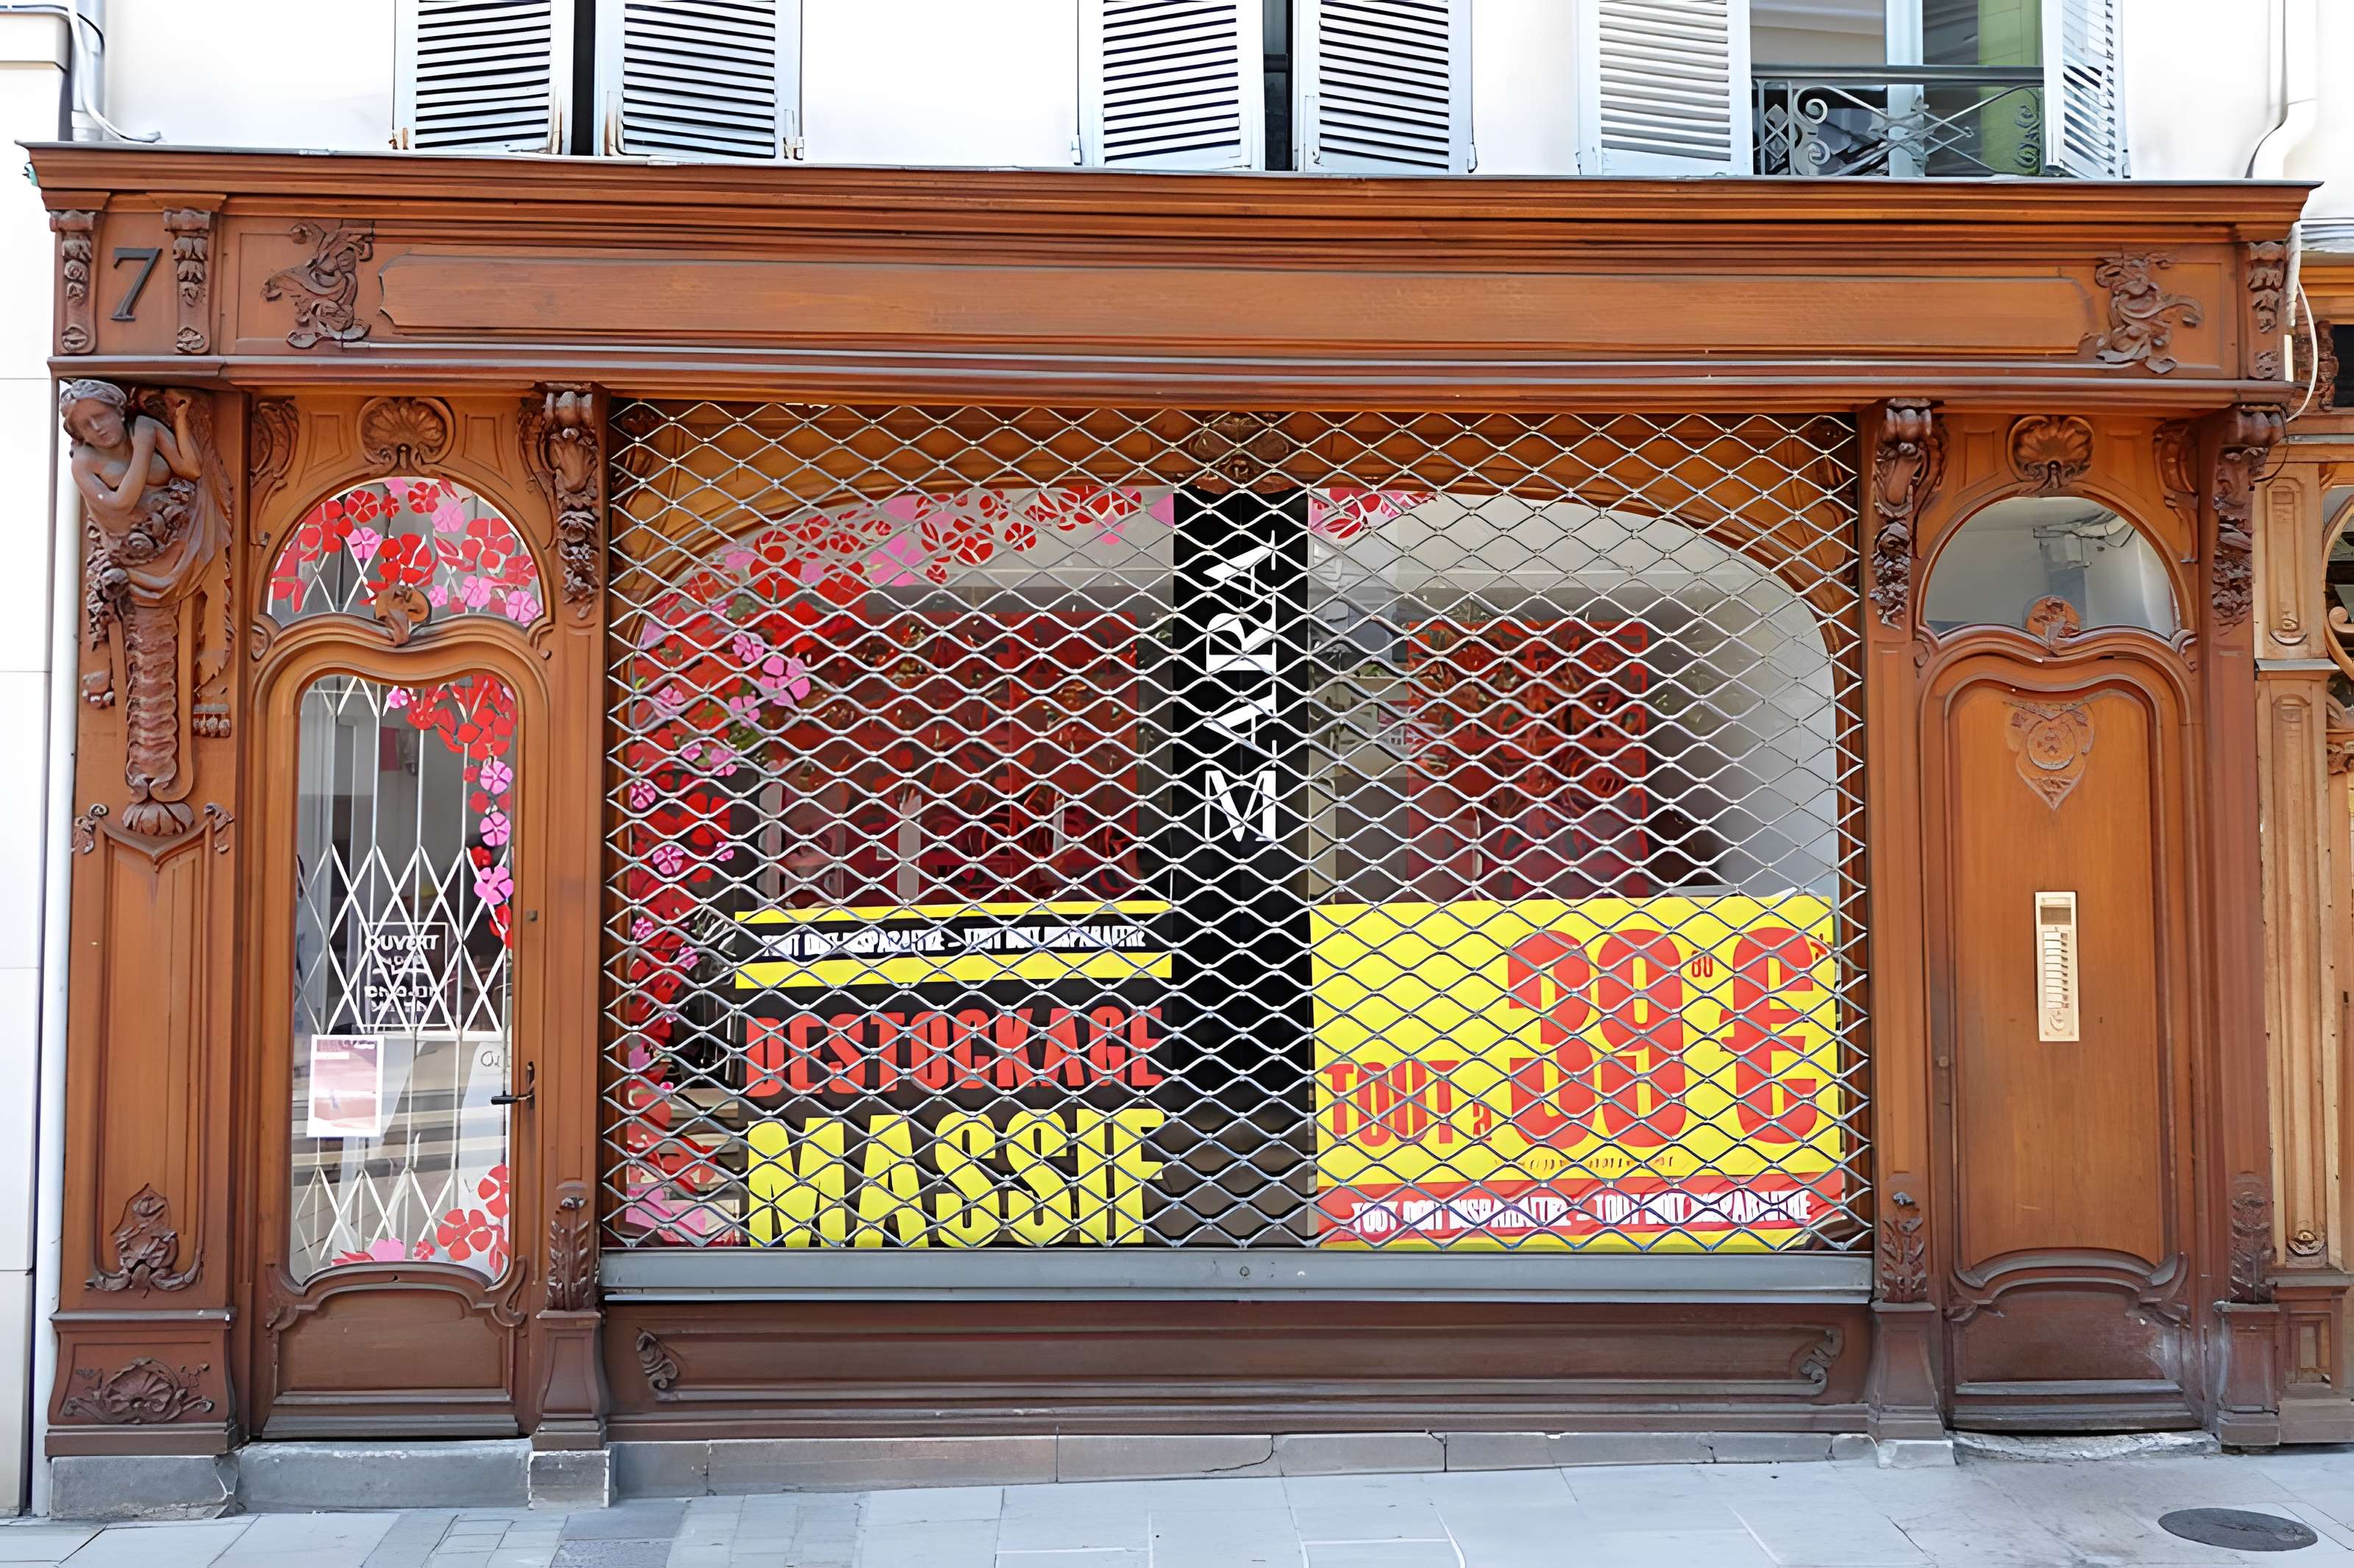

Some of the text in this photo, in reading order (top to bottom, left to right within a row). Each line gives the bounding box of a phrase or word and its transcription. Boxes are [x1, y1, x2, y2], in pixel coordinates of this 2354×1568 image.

[111, 247, 163, 322] 7
[1203, 530, 1278, 843] MARA
[1323, 1060, 1460, 1147] TOUT
[747, 1108, 1164, 1248] MASSIF
